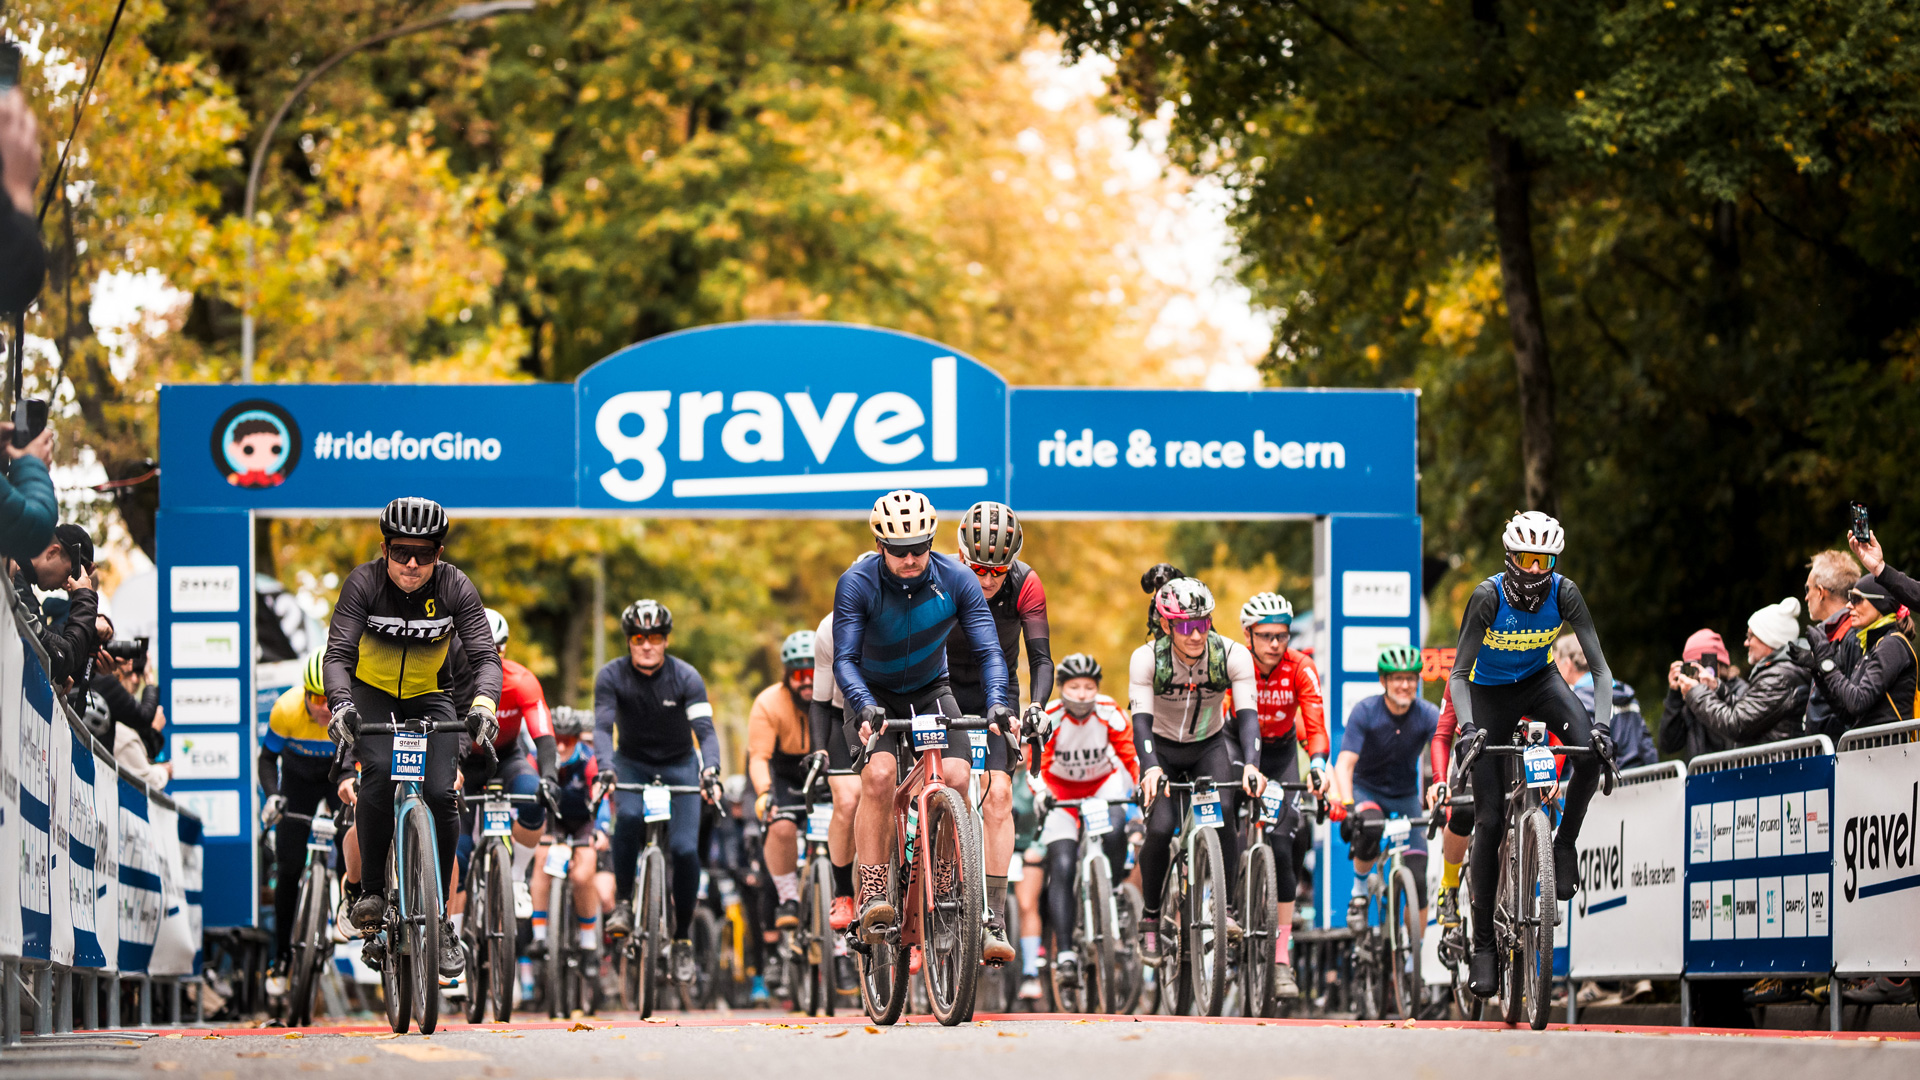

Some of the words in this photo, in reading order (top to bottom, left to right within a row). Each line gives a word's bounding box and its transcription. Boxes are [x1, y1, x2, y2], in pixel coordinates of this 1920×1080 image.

[596, 357, 957, 501] gravel
[315, 431, 501, 460] #rideforGino
[1039, 429, 1118, 467] ride
[1126, 430, 1156, 467] &
[1166, 441, 1245, 468] race
[1254, 430, 1345, 468] bern
[1257, 689, 1294, 700] HRAIN
[915, 731, 945, 741] 1582
[191, 752, 229, 765] EGK
[395, 752, 423, 764] 1541
[971, 747, 984, 759] 10
[396, 765, 421, 774] DOMINIC
[1526, 759, 1555, 771] 1608
[1201, 804, 1215, 815] 52
[1790, 817, 1802, 835] EGK
[1844, 781, 1919, 903] gravel
[1579, 819, 1624, 918] gravel
[1631, 862, 1642, 887] ride
[1649, 868, 1661, 886] race
[1661, 859, 1675, 885] bern
[1785, 899, 1801, 912] CRAFT
